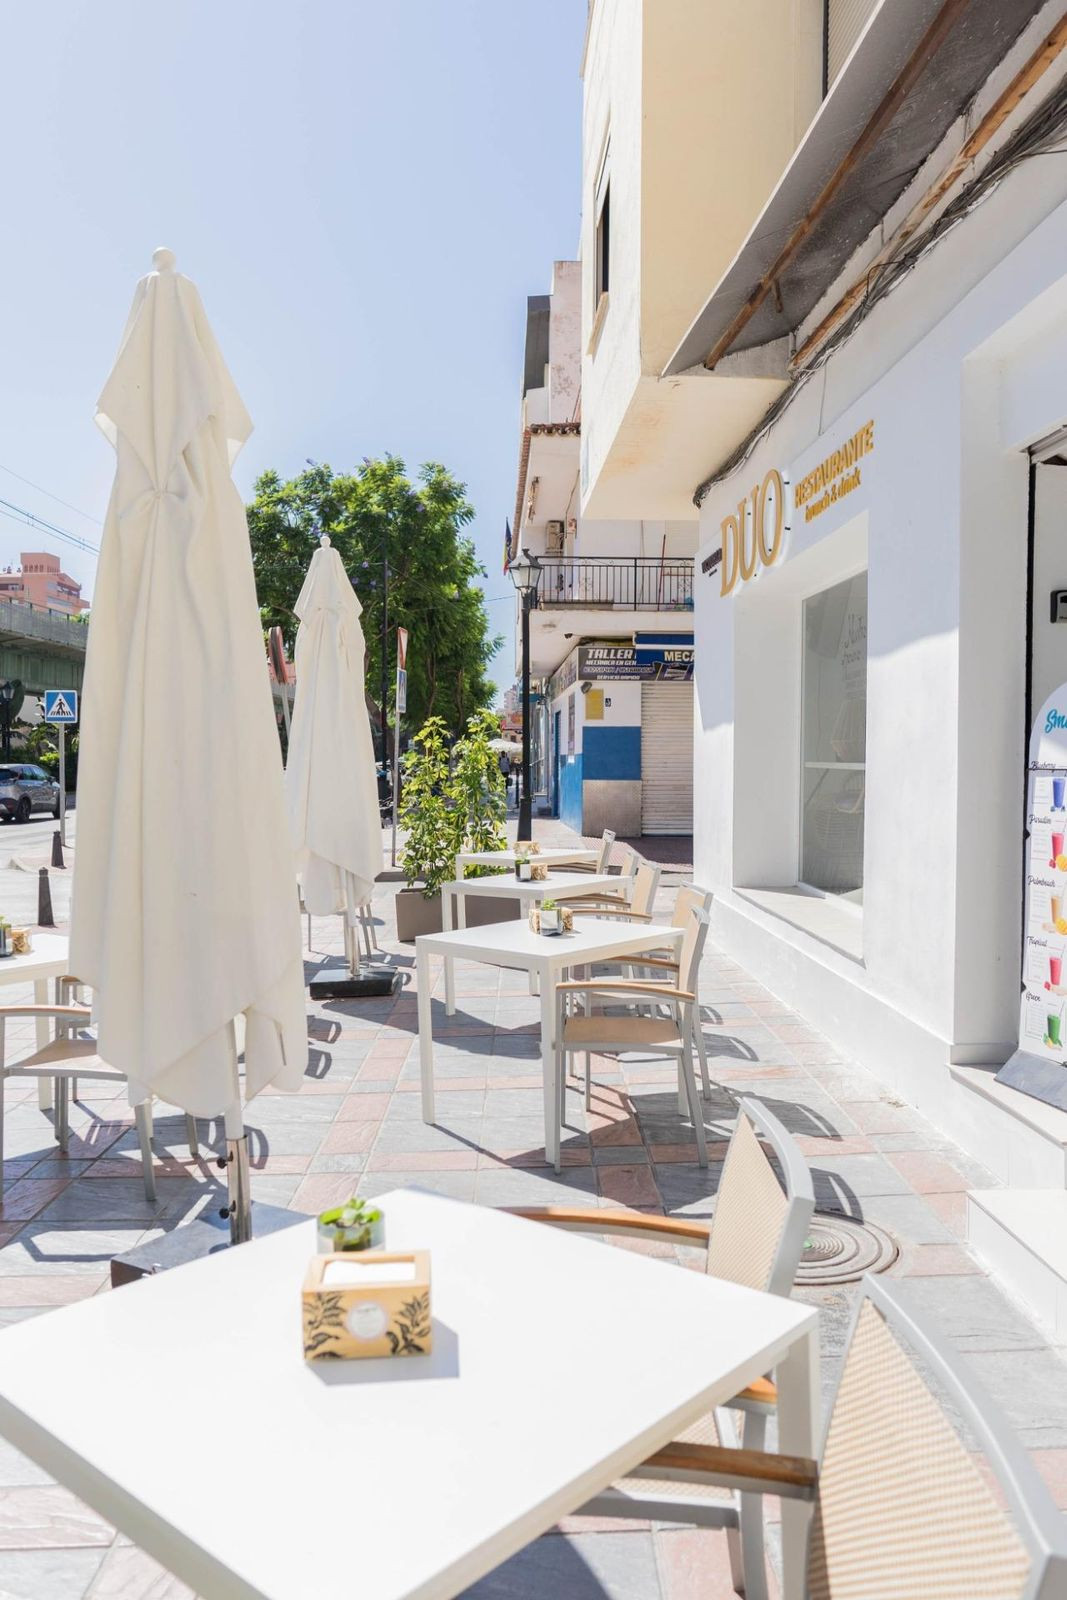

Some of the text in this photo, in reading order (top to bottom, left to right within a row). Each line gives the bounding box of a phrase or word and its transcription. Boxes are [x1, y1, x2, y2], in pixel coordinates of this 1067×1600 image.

[794, 419, 874, 509] RESTAURANTE
[831, 484, 837, 504] &
[720, 469, 784, 597] DUO
[587, 648, 634, 660] TALLER
